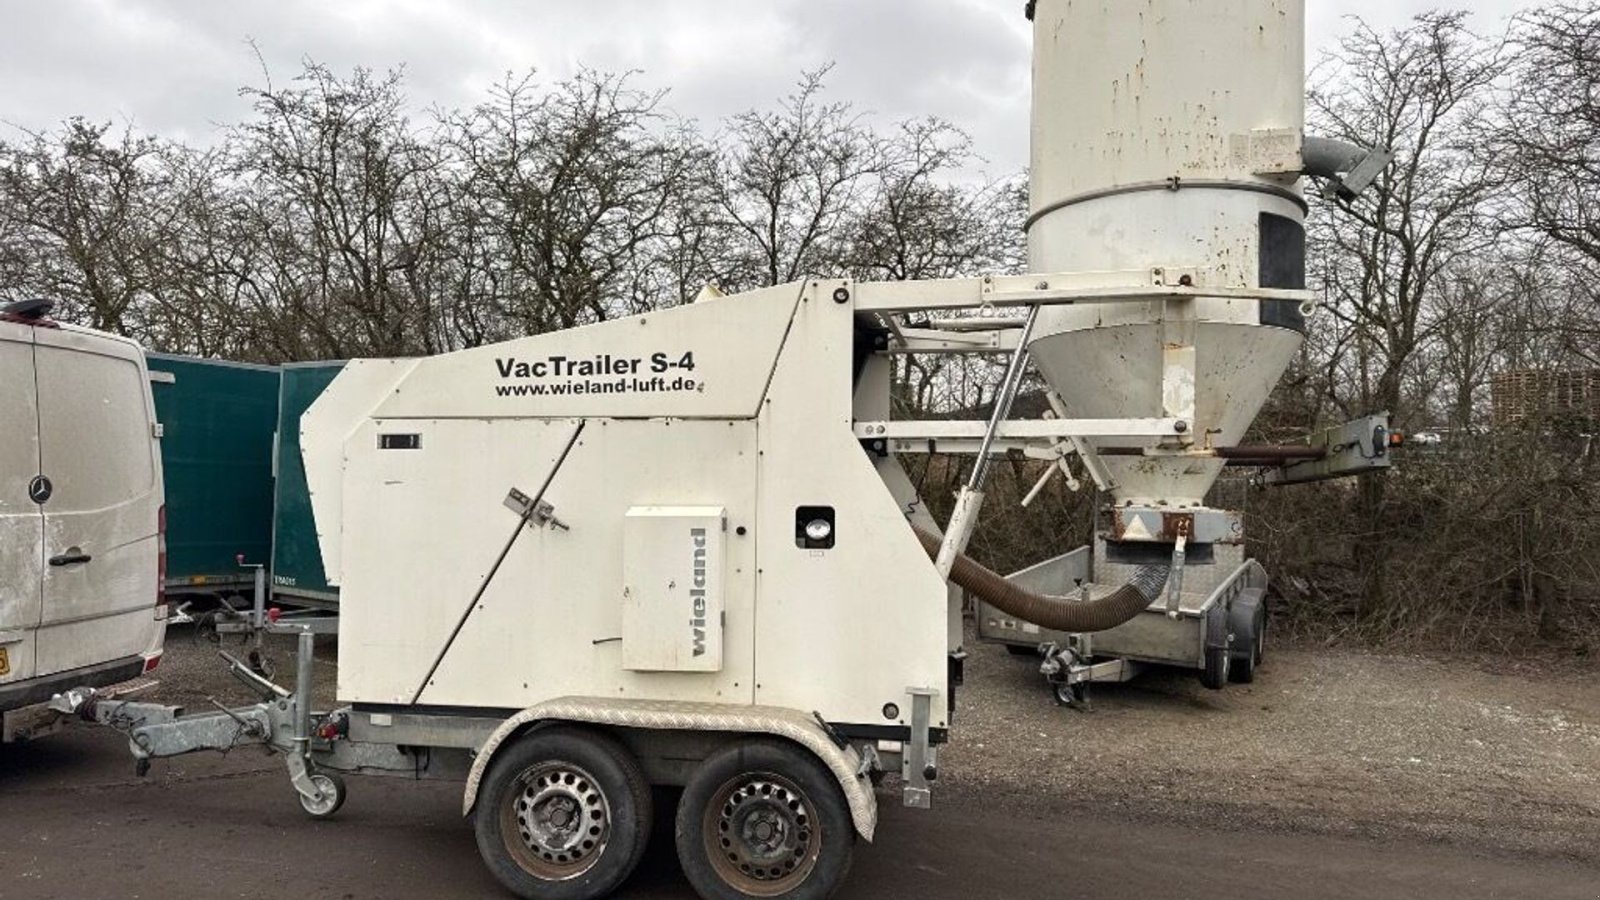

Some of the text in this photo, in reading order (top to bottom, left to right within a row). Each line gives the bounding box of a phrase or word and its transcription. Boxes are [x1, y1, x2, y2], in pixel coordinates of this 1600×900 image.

[495, 351, 695, 378] VacTrailer S-4
[495, 377, 695, 396] www.wieland-luft.de
[689, 528, 706, 657] wieland
